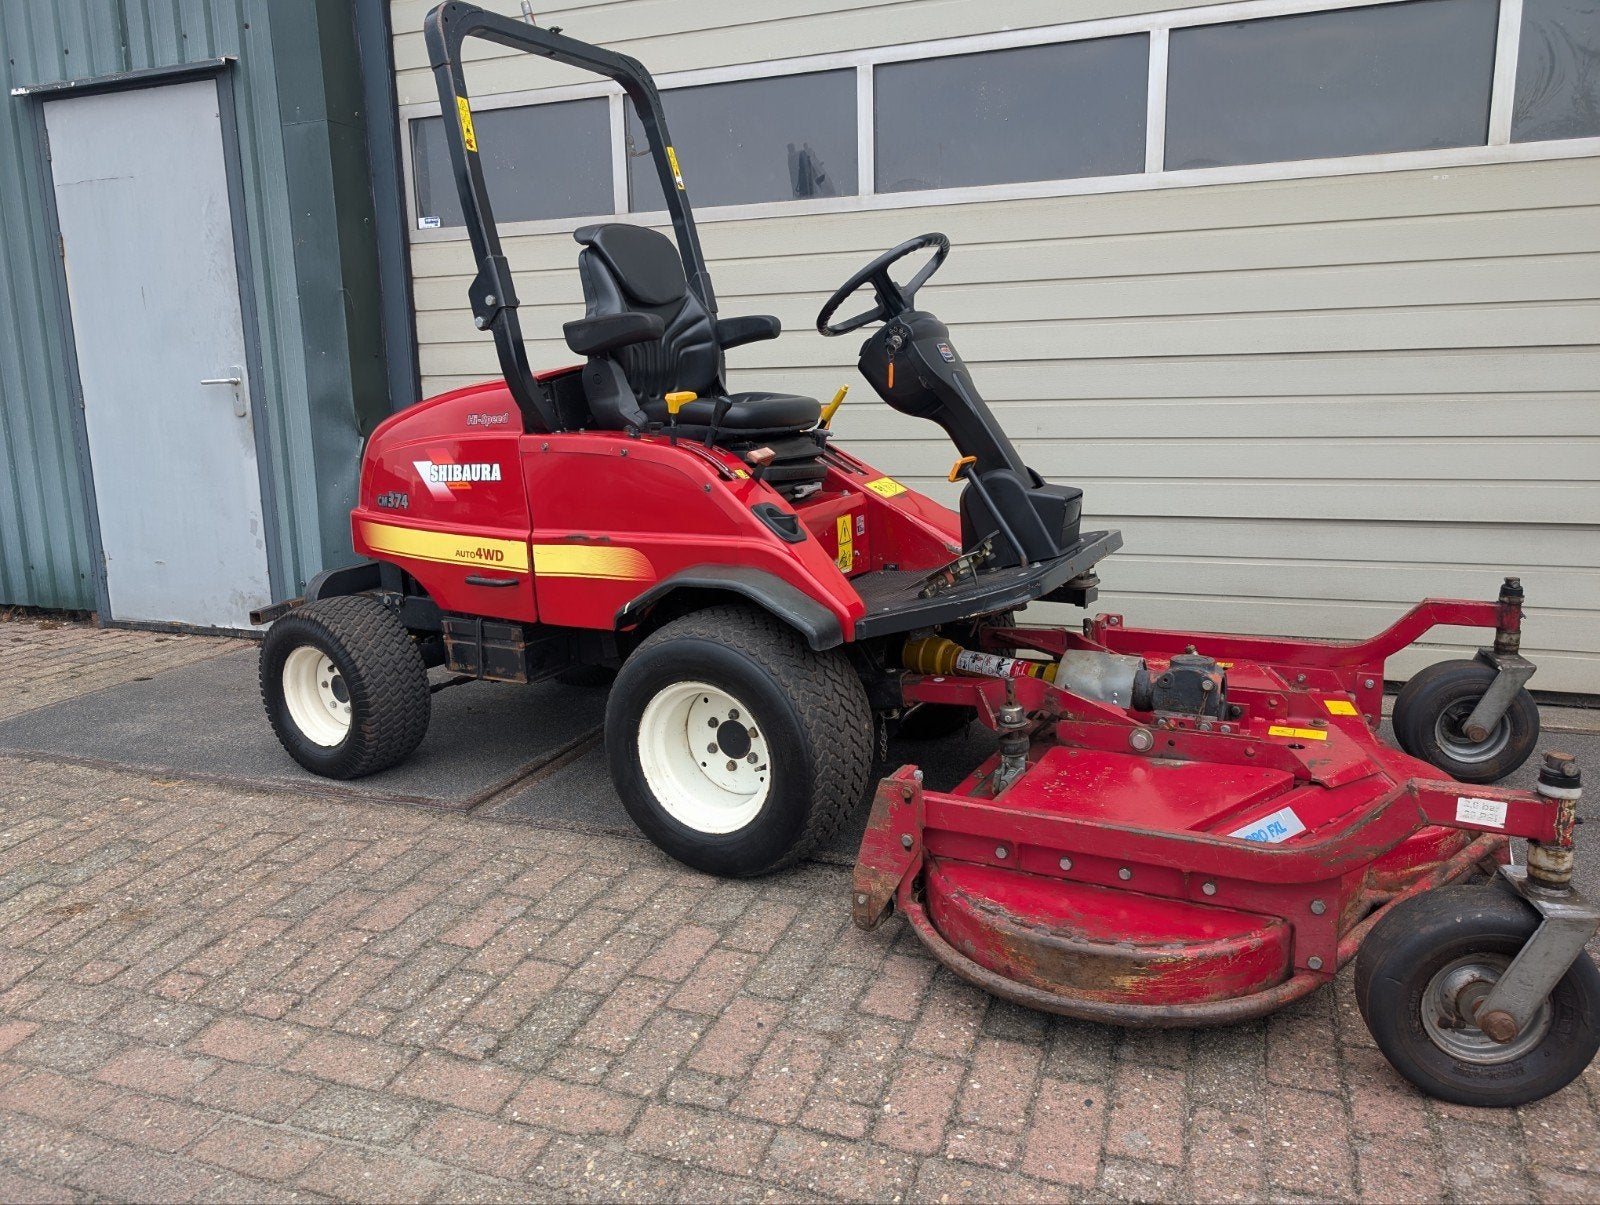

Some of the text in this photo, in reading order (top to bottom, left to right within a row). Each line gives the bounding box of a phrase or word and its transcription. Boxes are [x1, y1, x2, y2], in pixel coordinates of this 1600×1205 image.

[467, 413, 509, 427] Hi-Speed
[430, 463, 502, 482] SHIBAURA
[377, 491, 409, 509] CM374
[1266, 821, 1288, 838] FXL
